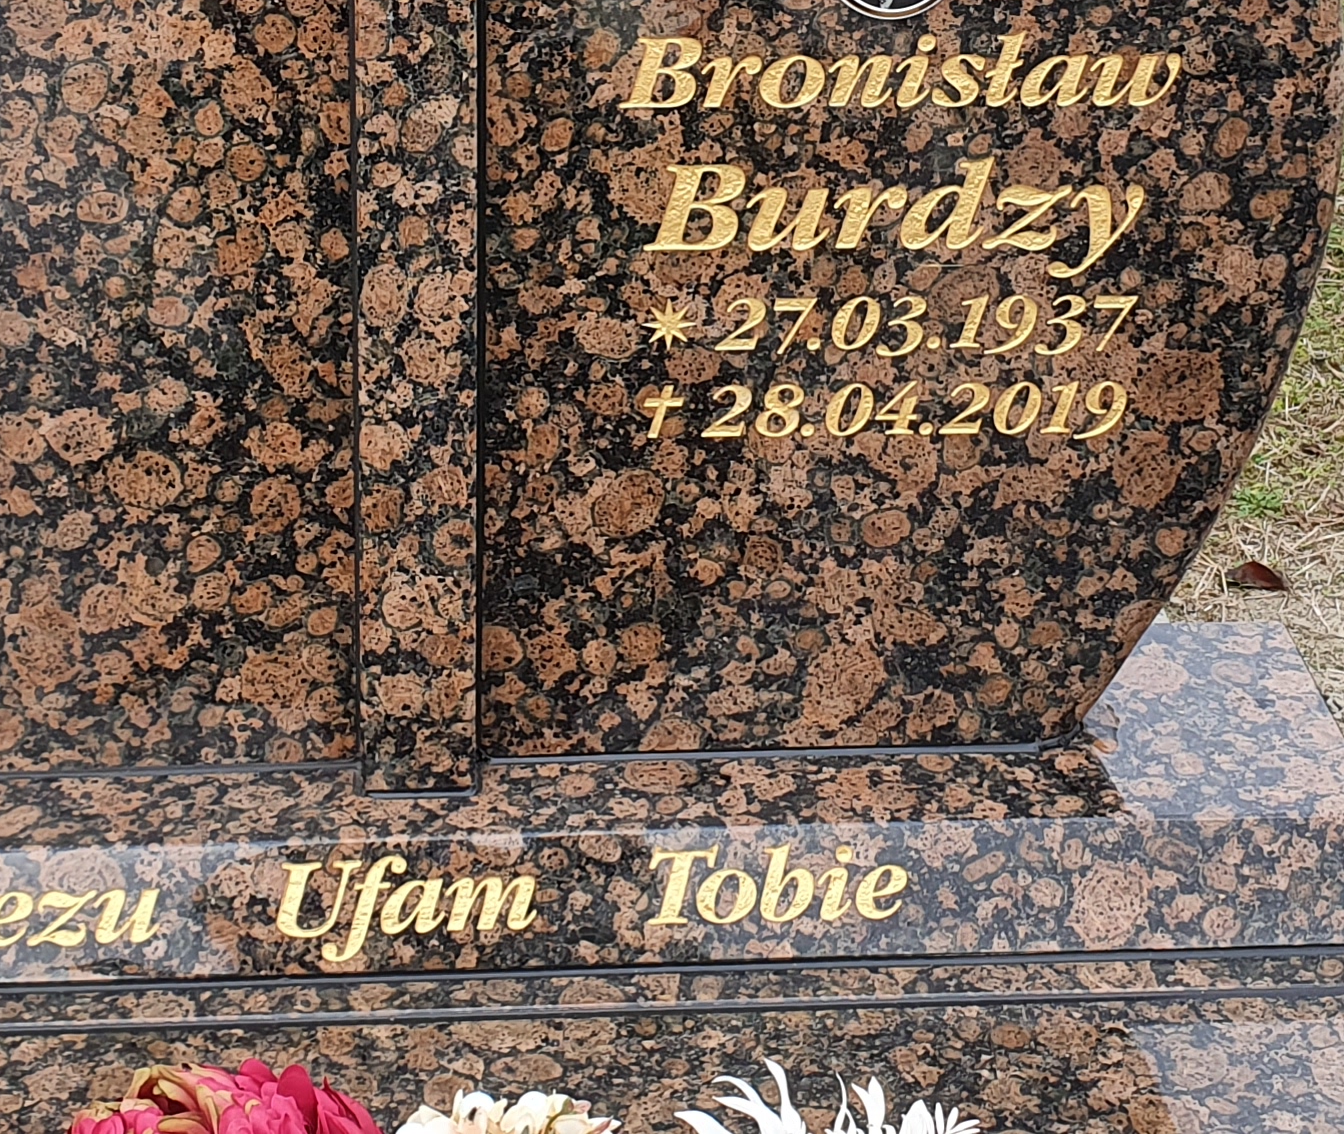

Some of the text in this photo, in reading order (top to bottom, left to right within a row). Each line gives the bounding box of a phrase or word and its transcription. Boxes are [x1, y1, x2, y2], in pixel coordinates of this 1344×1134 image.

[619, 32, 1182, 110] Bronisław
[642, 157, 1146, 278] Burdzy
[714, 294, 1139, 356] 27.03.1937
[701, 380, 1129, 440] 28.04.2019
[276, 855, 538, 963] Ufam
[646, 843, 908, 925] Tobie
